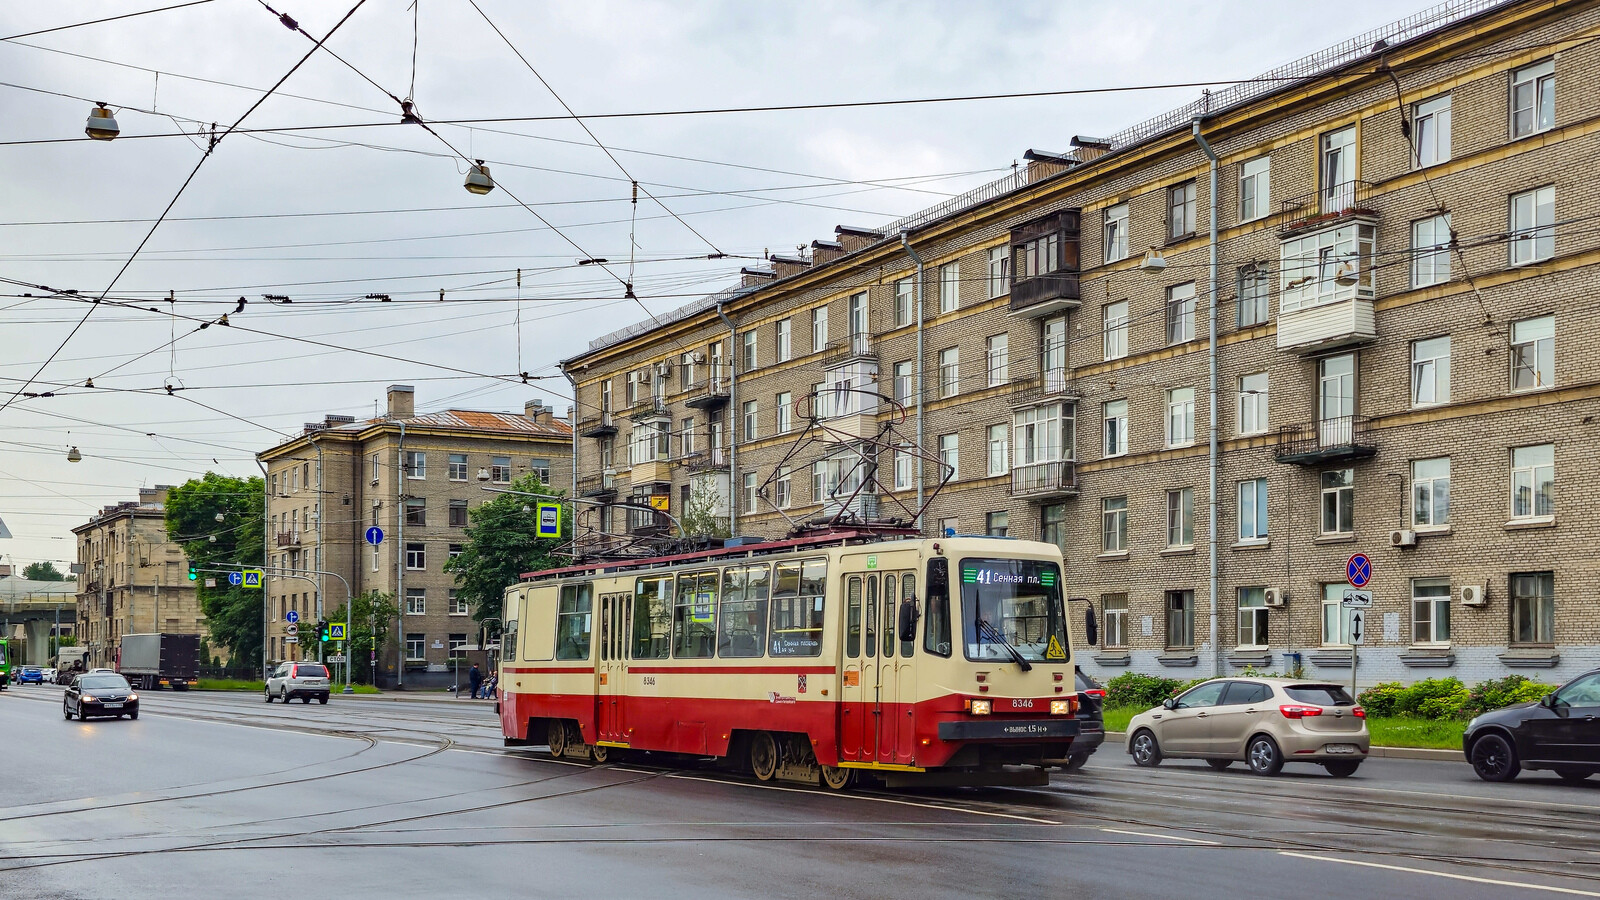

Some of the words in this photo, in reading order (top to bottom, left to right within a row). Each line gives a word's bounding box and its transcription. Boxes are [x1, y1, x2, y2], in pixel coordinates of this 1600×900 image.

[976, 569, 991, 584] 41
[993, 572, 1023, 584] Сенная
[1027, 575, 1040, 584] пл.
[773, 640, 781, 653] 41
[643, 676, 656, 685] 8346
[1012, 699, 1033, 708] 8346
